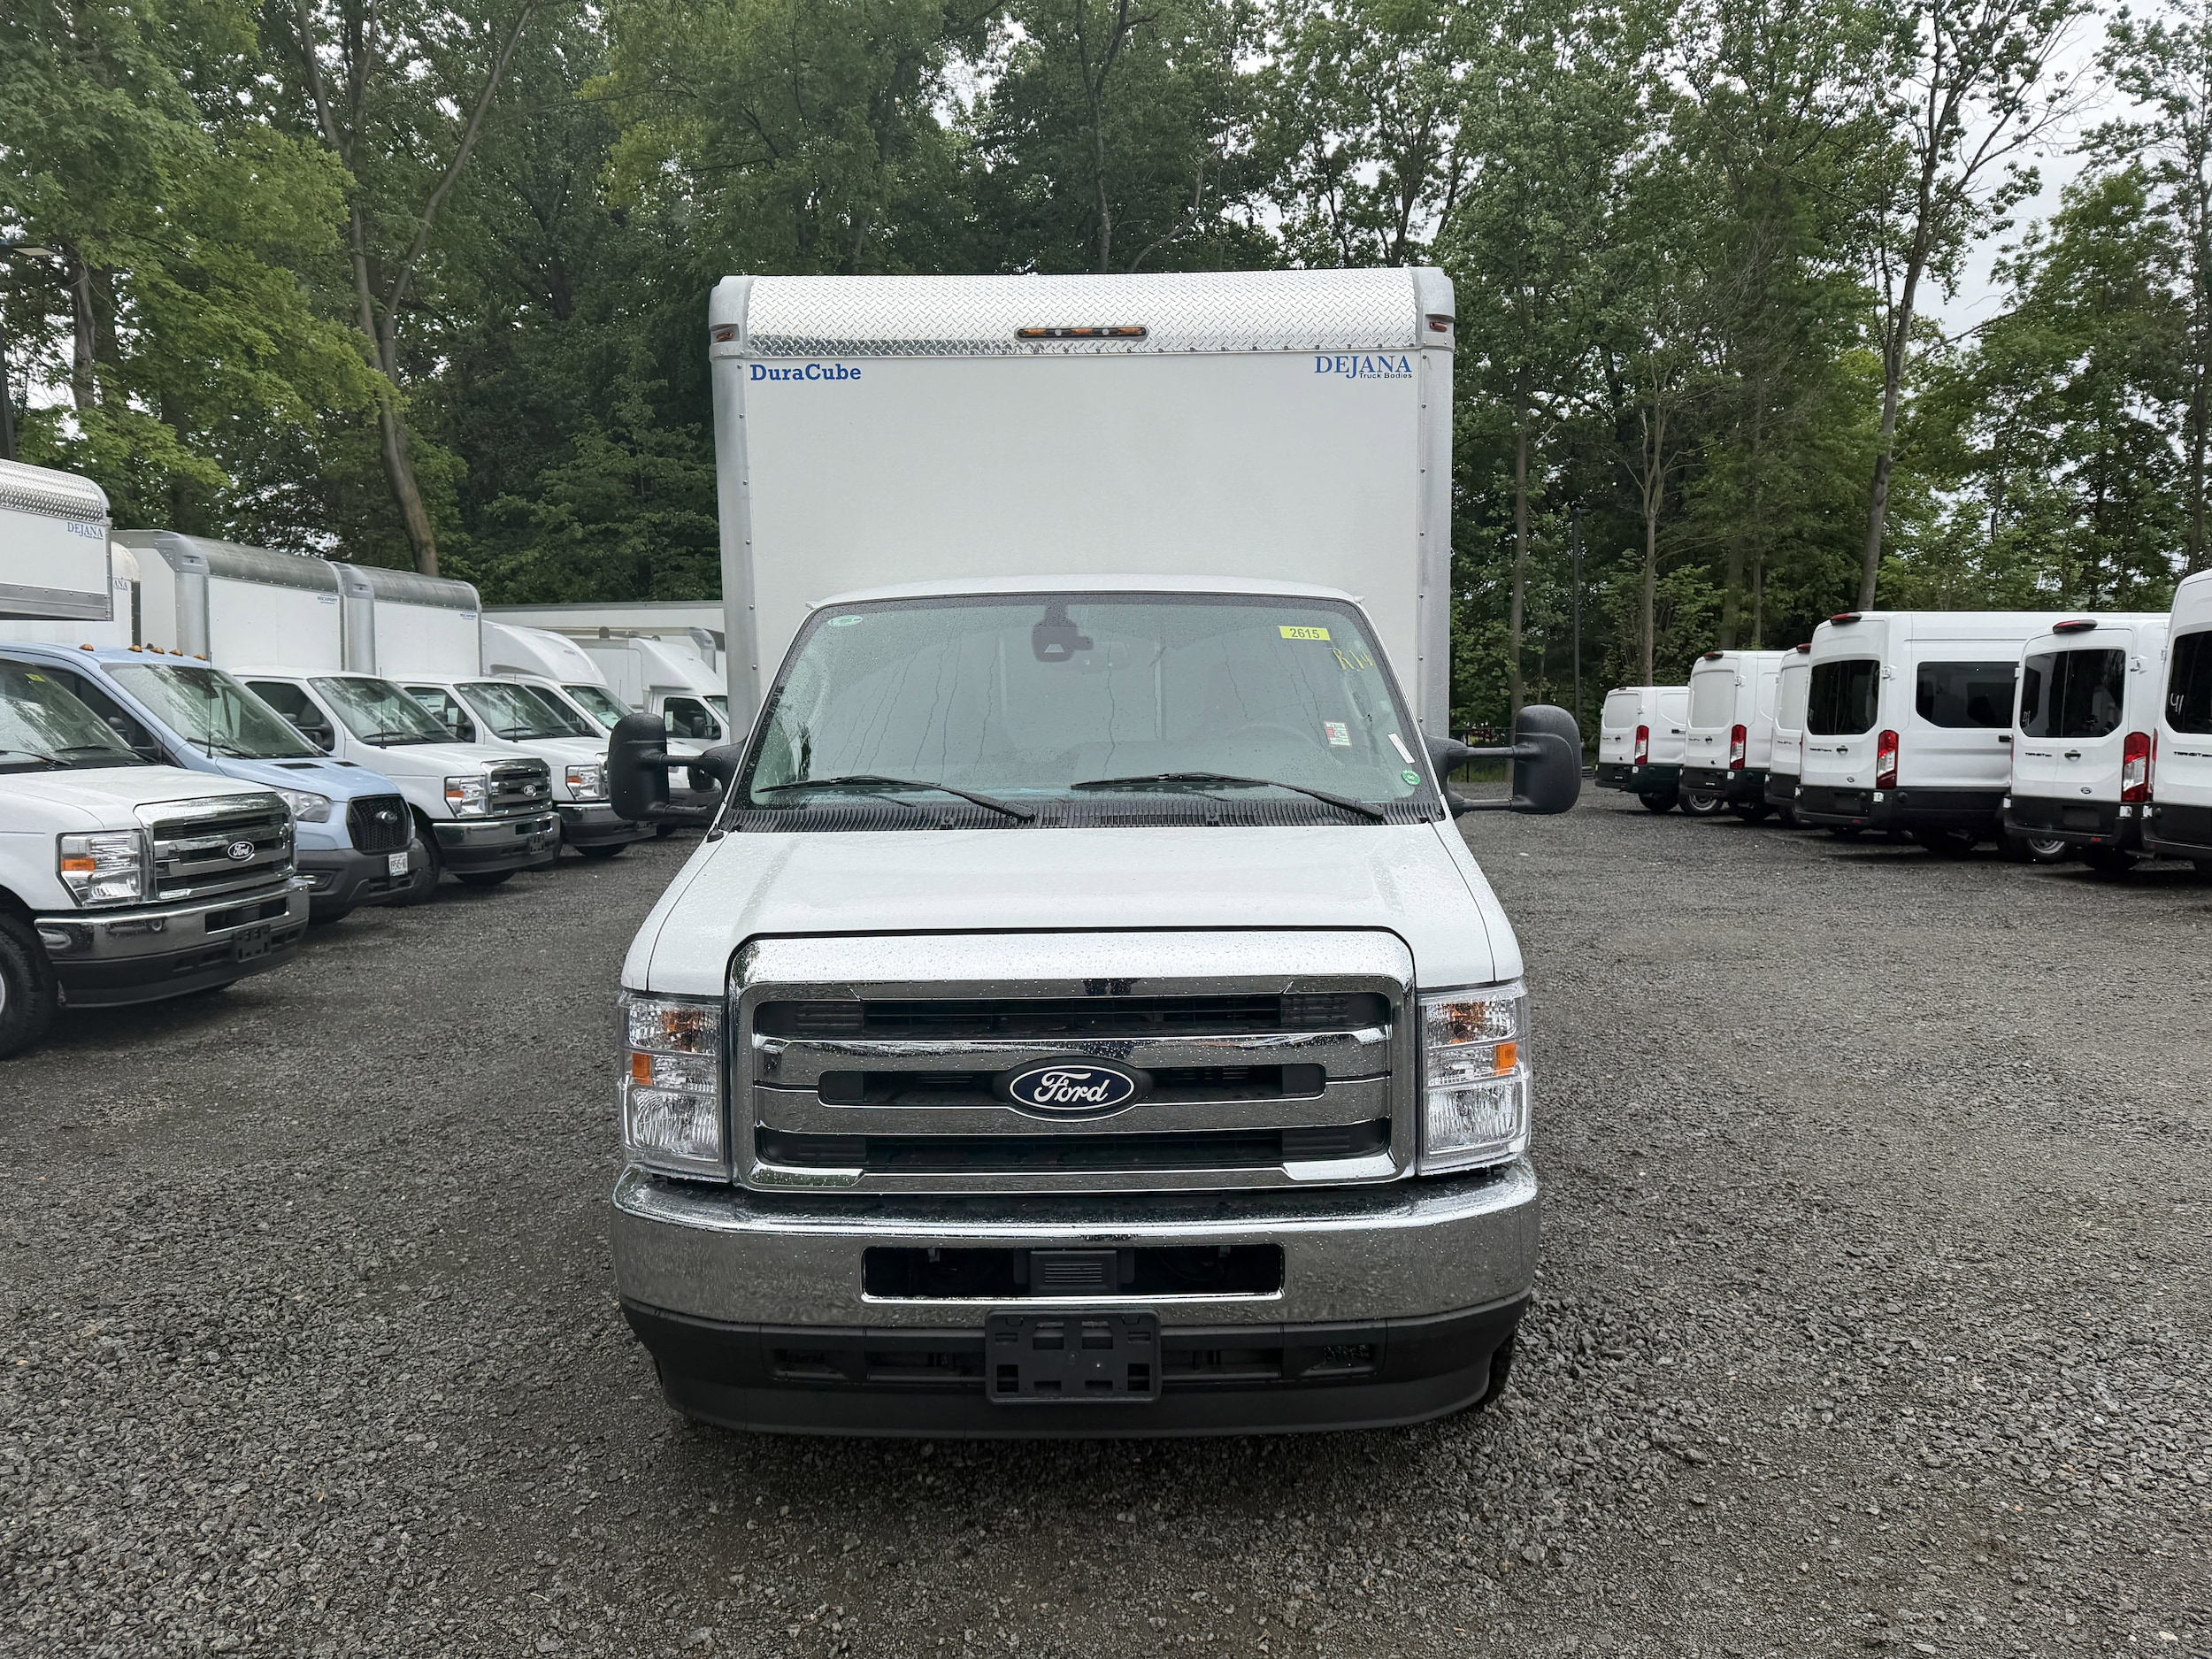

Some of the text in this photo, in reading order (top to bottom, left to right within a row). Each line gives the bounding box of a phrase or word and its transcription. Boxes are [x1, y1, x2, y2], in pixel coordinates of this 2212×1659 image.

[749, 364, 862, 380] DuraCube
[1314, 355, 1412, 379] DEJANA
[67, 522, 104, 537] DEJANA
[1290, 628, 1319, 639] 2615
[233, 843, 250, 856] Ford
[1033, 1071, 1110, 1102] Ford
